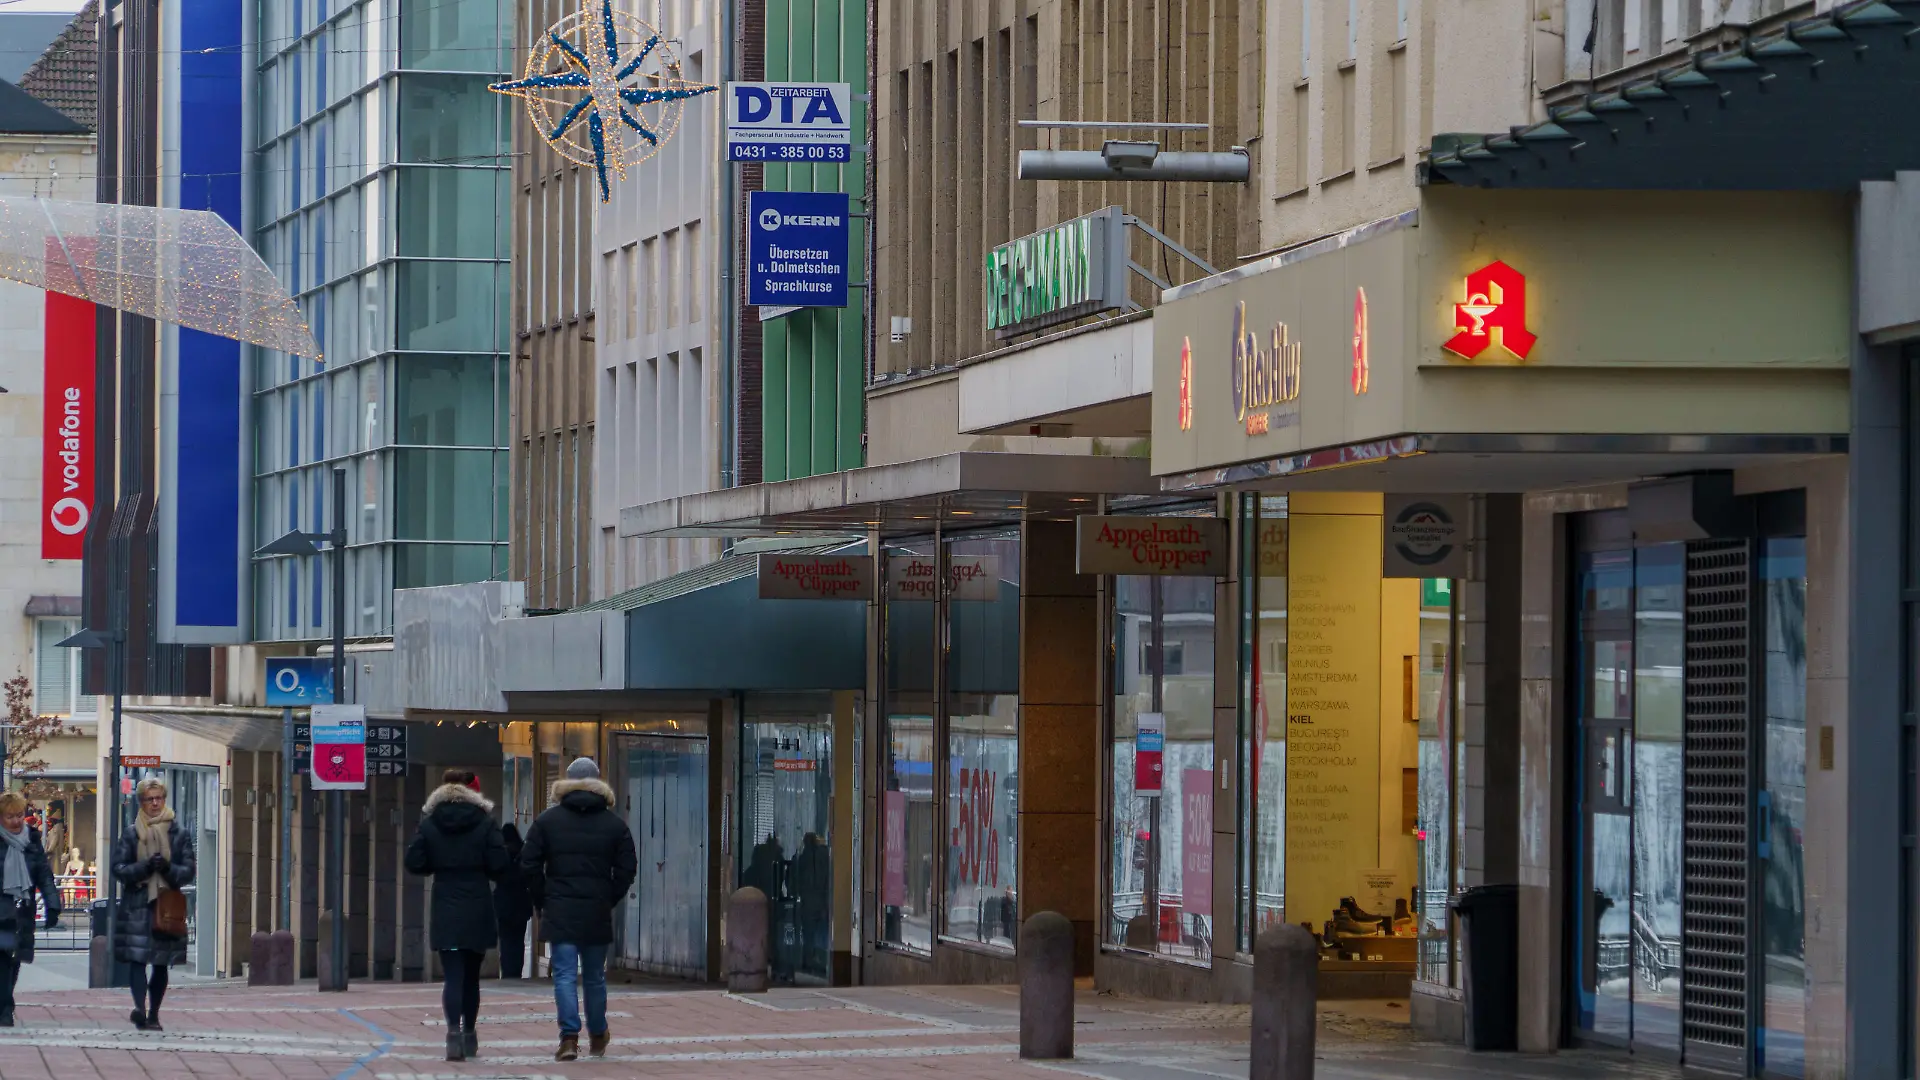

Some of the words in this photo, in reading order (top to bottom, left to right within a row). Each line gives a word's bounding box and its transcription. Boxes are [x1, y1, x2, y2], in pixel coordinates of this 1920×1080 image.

[771, 88, 829, 98] ZEITARBEIT
[735, 86, 844, 124] DTA
[735, 145, 766, 158] 0431
[780, 146, 804, 159] 385
[808, 146, 824, 159] 00
[828, 146, 844, 159] 53
[783, 215, 840, 227] KERN
[769, 243, 829, 260] Übersetzen
[757, 263, 768, 273] u.
[771, 261, 840, 274] Dolmetschen
[986, 217, 1091, 331] DEICHMANN
[765, 279, 833, 294] Sprachkurse
[58, 387, 81, 492] vodafone
[1097, 522, 1207, 549] Appelrath-
[1132, 543, 1212, 570] Cüpper
[798, 574, 861, 595] Cüpper
[1290, 617, 1336, 627] LONDON
[1290, 631, 1323, 640] ROMA
[1290, 645, 1333, 654] ZAGREB
[1290, 659, 1330, 669] VILNIUS
[1290, 673, 1358, 683] AMSTERDAM
[1290, 687, 1318, 696] WIEN
[1290, 701, 1350, 710] WARSZAWA
[1289, 715, 1315, 724] KIEL
[1289, 742, 1342, 752] BEOGRAD
[1289, 756, 1357, 766] STOCKHOLM
[1289, 770, 1318, 780] BERN
[1188, 793, 1210, 847] 50%
[953, 768, 999, 889] -50%
